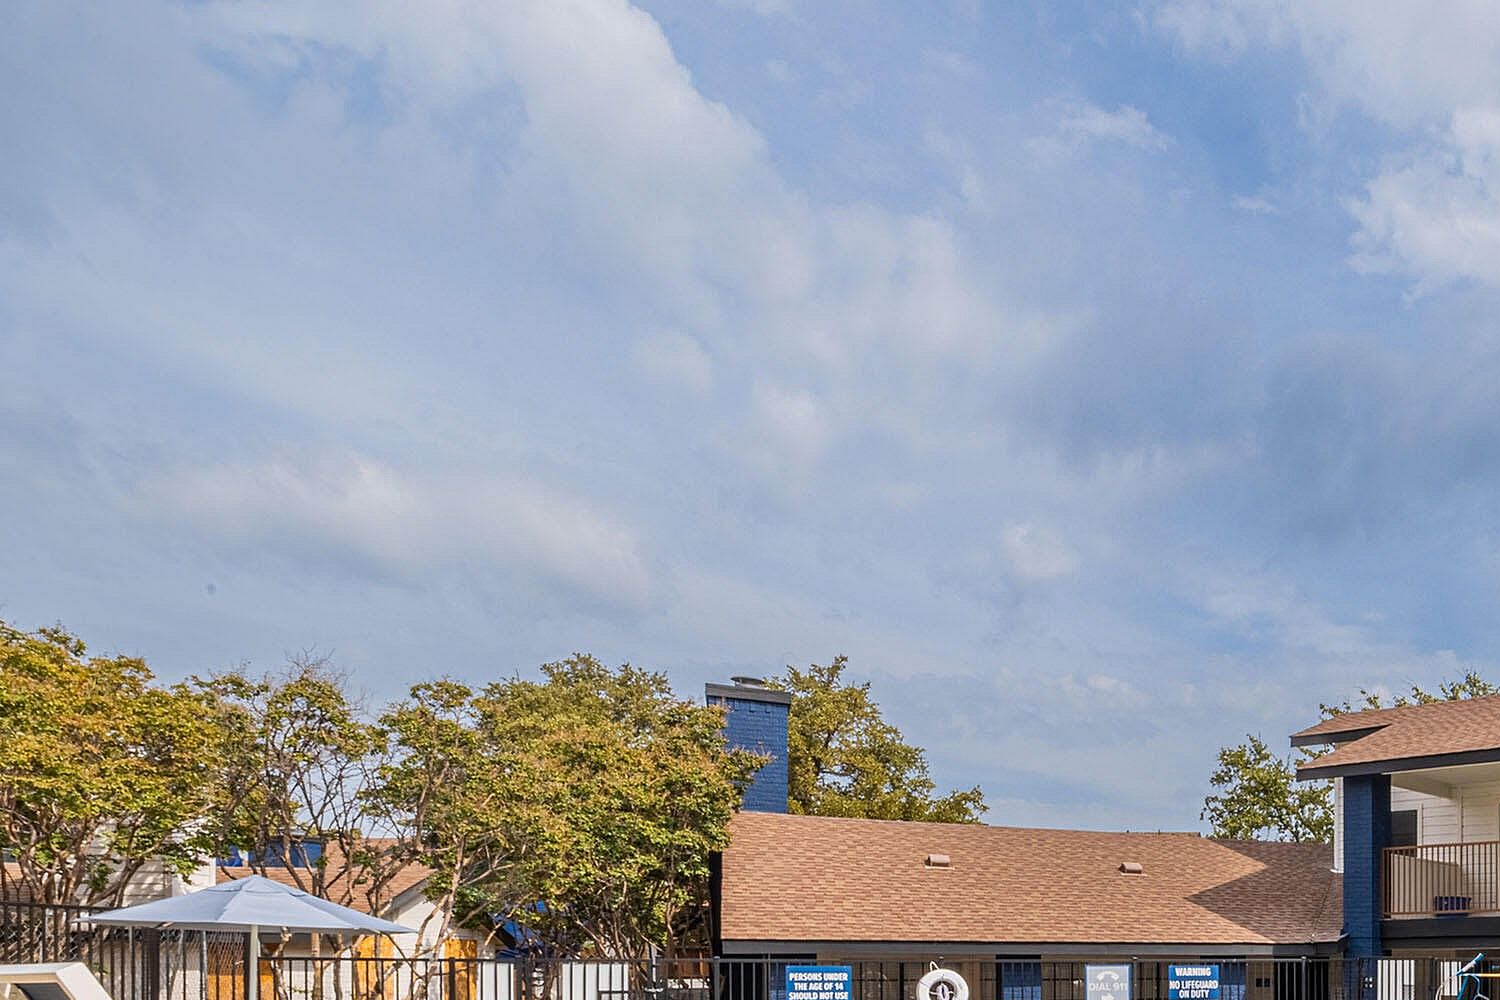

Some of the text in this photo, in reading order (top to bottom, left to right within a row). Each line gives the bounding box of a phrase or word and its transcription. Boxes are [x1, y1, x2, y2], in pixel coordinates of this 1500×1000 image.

[788, 972, 849, 981] PERSONS UNDER
[1175, 967, 1212, 977] WARNING
[794, 982, 844, 991] THE AGE OF 14
[1089, 982, 1128, 991] DIAL 911
[1169, 980, 1218, 990] NO LIFEGUARD
[788, 992, 849, 1000] SHOULD NOT USE
[1178, 990, 1210, 999] ON DUTY
